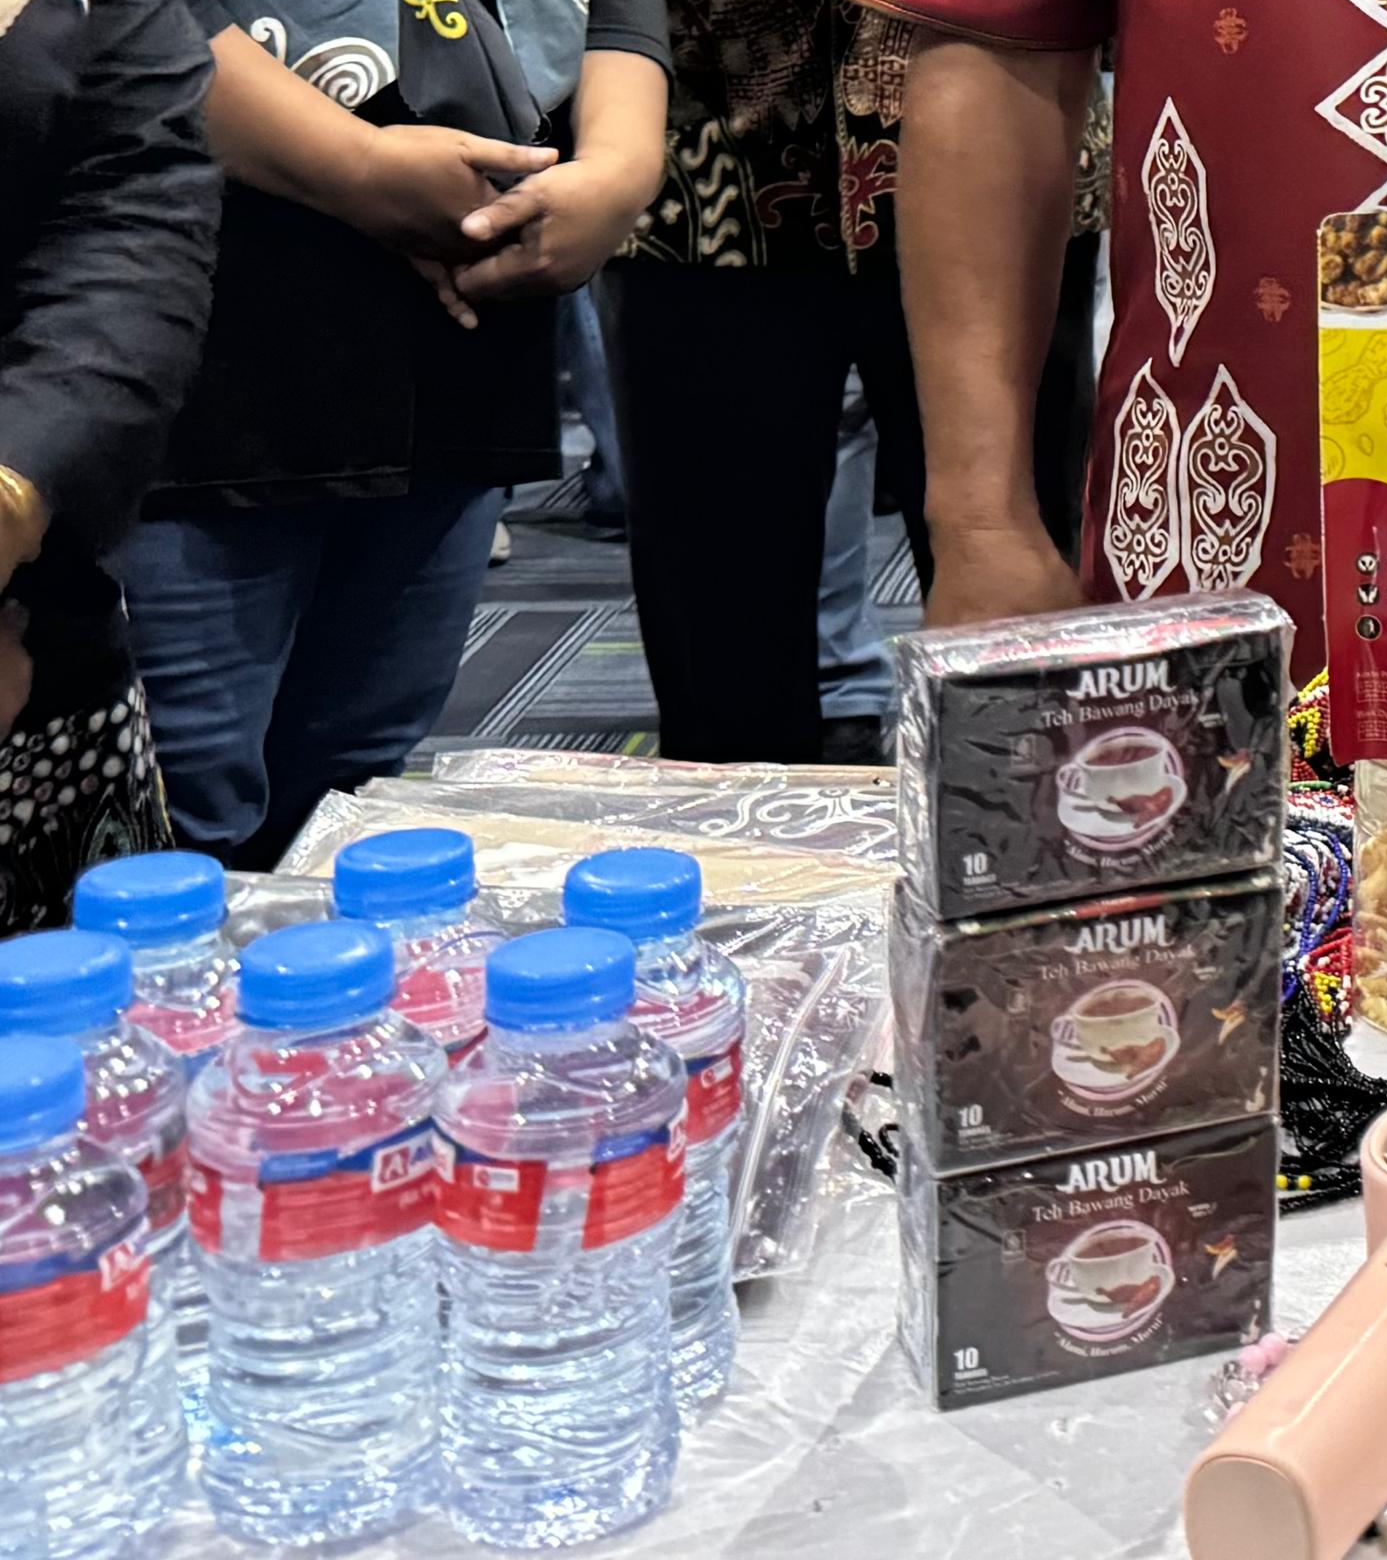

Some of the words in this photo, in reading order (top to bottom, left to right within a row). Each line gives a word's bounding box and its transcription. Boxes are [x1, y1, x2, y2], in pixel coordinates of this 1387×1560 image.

[1066, 659, 1177, 700] ARUM
[1042, 710, 1073, 728] Teh
[1079, 700, 1145, 723] Bawang
[1149, 690, 1200, 713] Dayak
[963, 852, 988, 875] 10
[1064, 914, 1176, 955] ARUM
[1039, 963, 1069, 981] Teh
[1075, 955, 1140, 975] Bawang
[958, 1104, 983, 1128] 10
[1056, 1150, 1167, 1193] ARUM
[1032, 1206, 1063, 1223] Teh
[1068, 1194, 1134, 1216] Bawang
[1138, 1181, 1190, 1203] Dayak
[953, 1347, 979, 1370] 10
